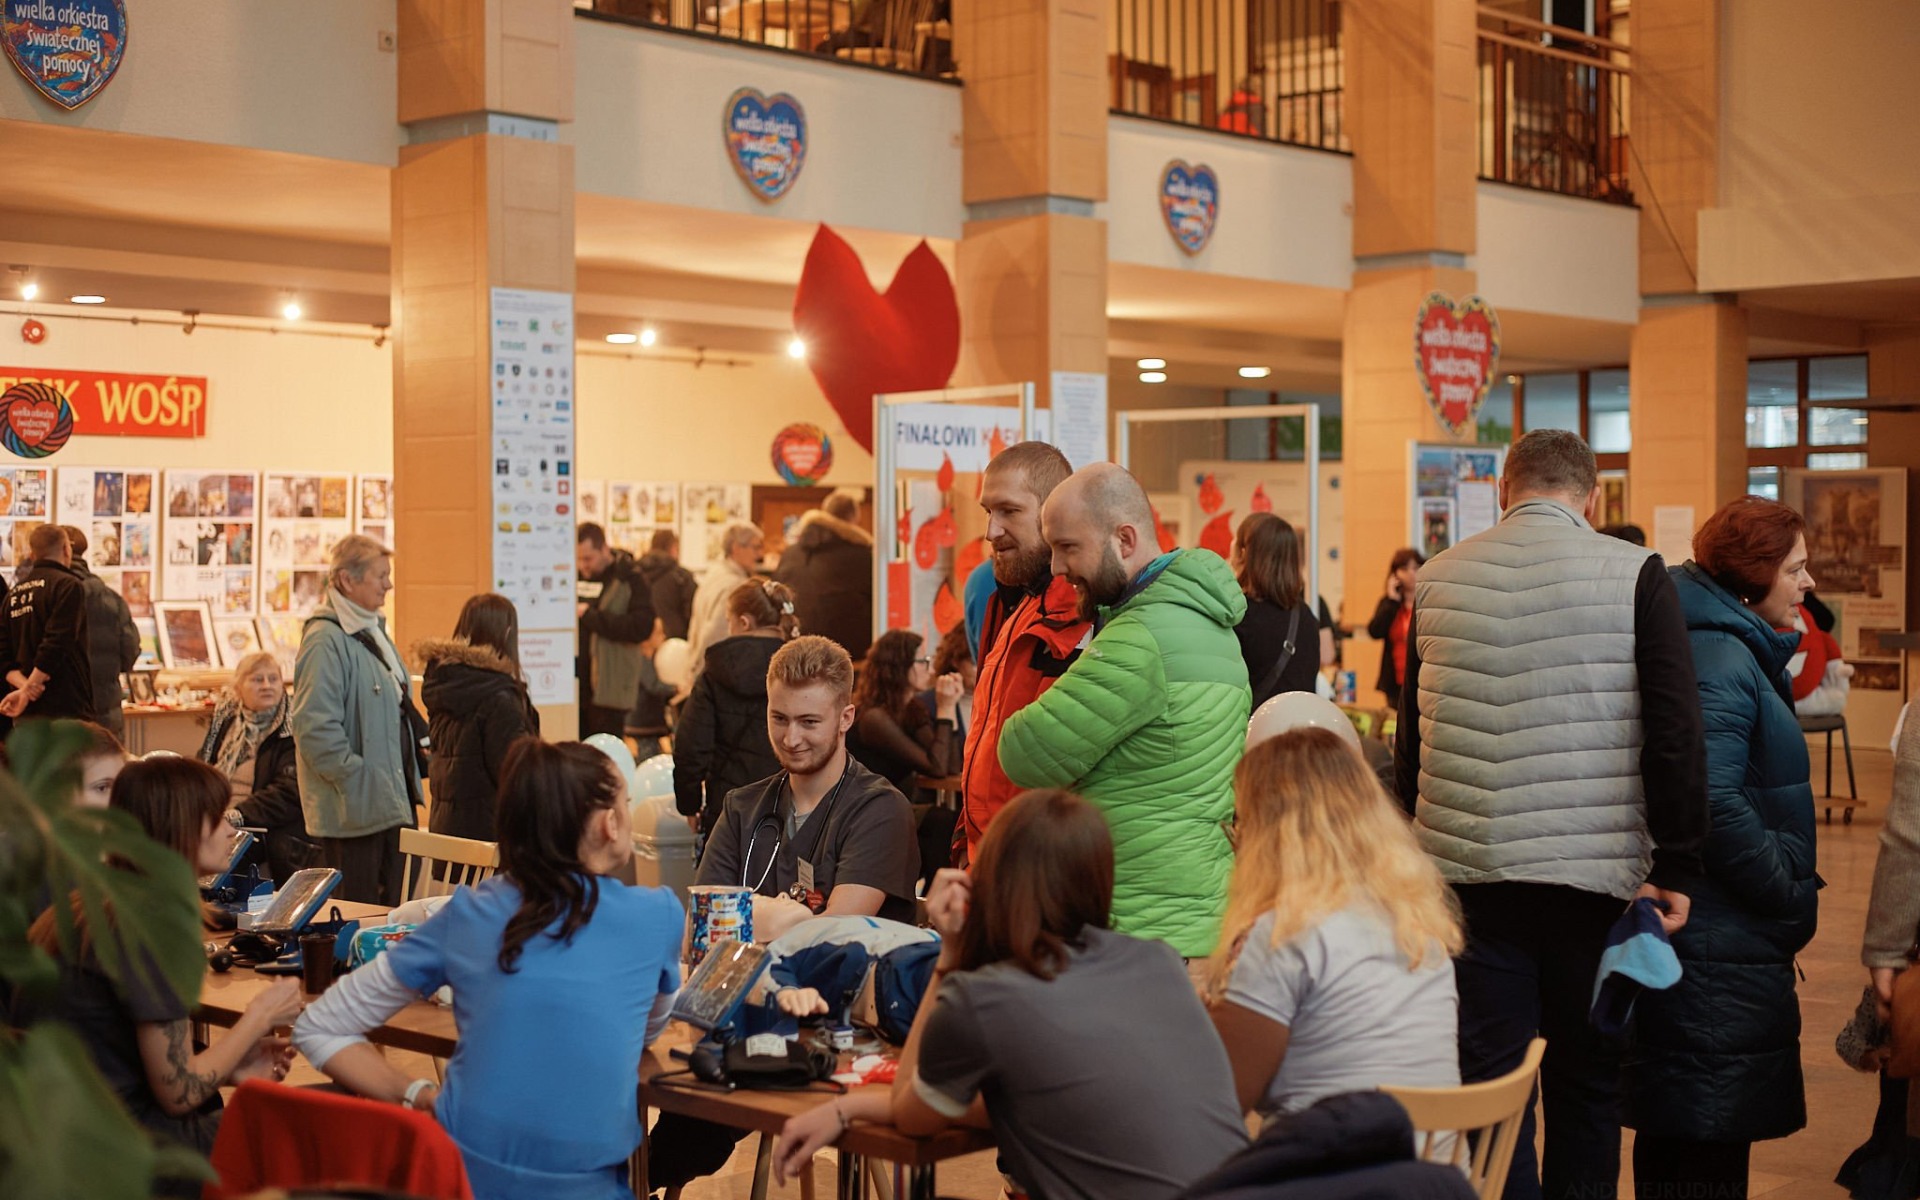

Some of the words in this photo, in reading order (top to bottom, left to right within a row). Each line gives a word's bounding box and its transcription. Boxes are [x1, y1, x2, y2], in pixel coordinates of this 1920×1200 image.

[15, 0, 55, 21] wielka
[58, 3, 109, 31] orkiestra
[27, 23, 101, 63] świątecznej
[43, 55, 91, 82] pomocy
[95, 376, 203, 427] WOŚP
[897, 422, 977, 446] FINAŁOWI
